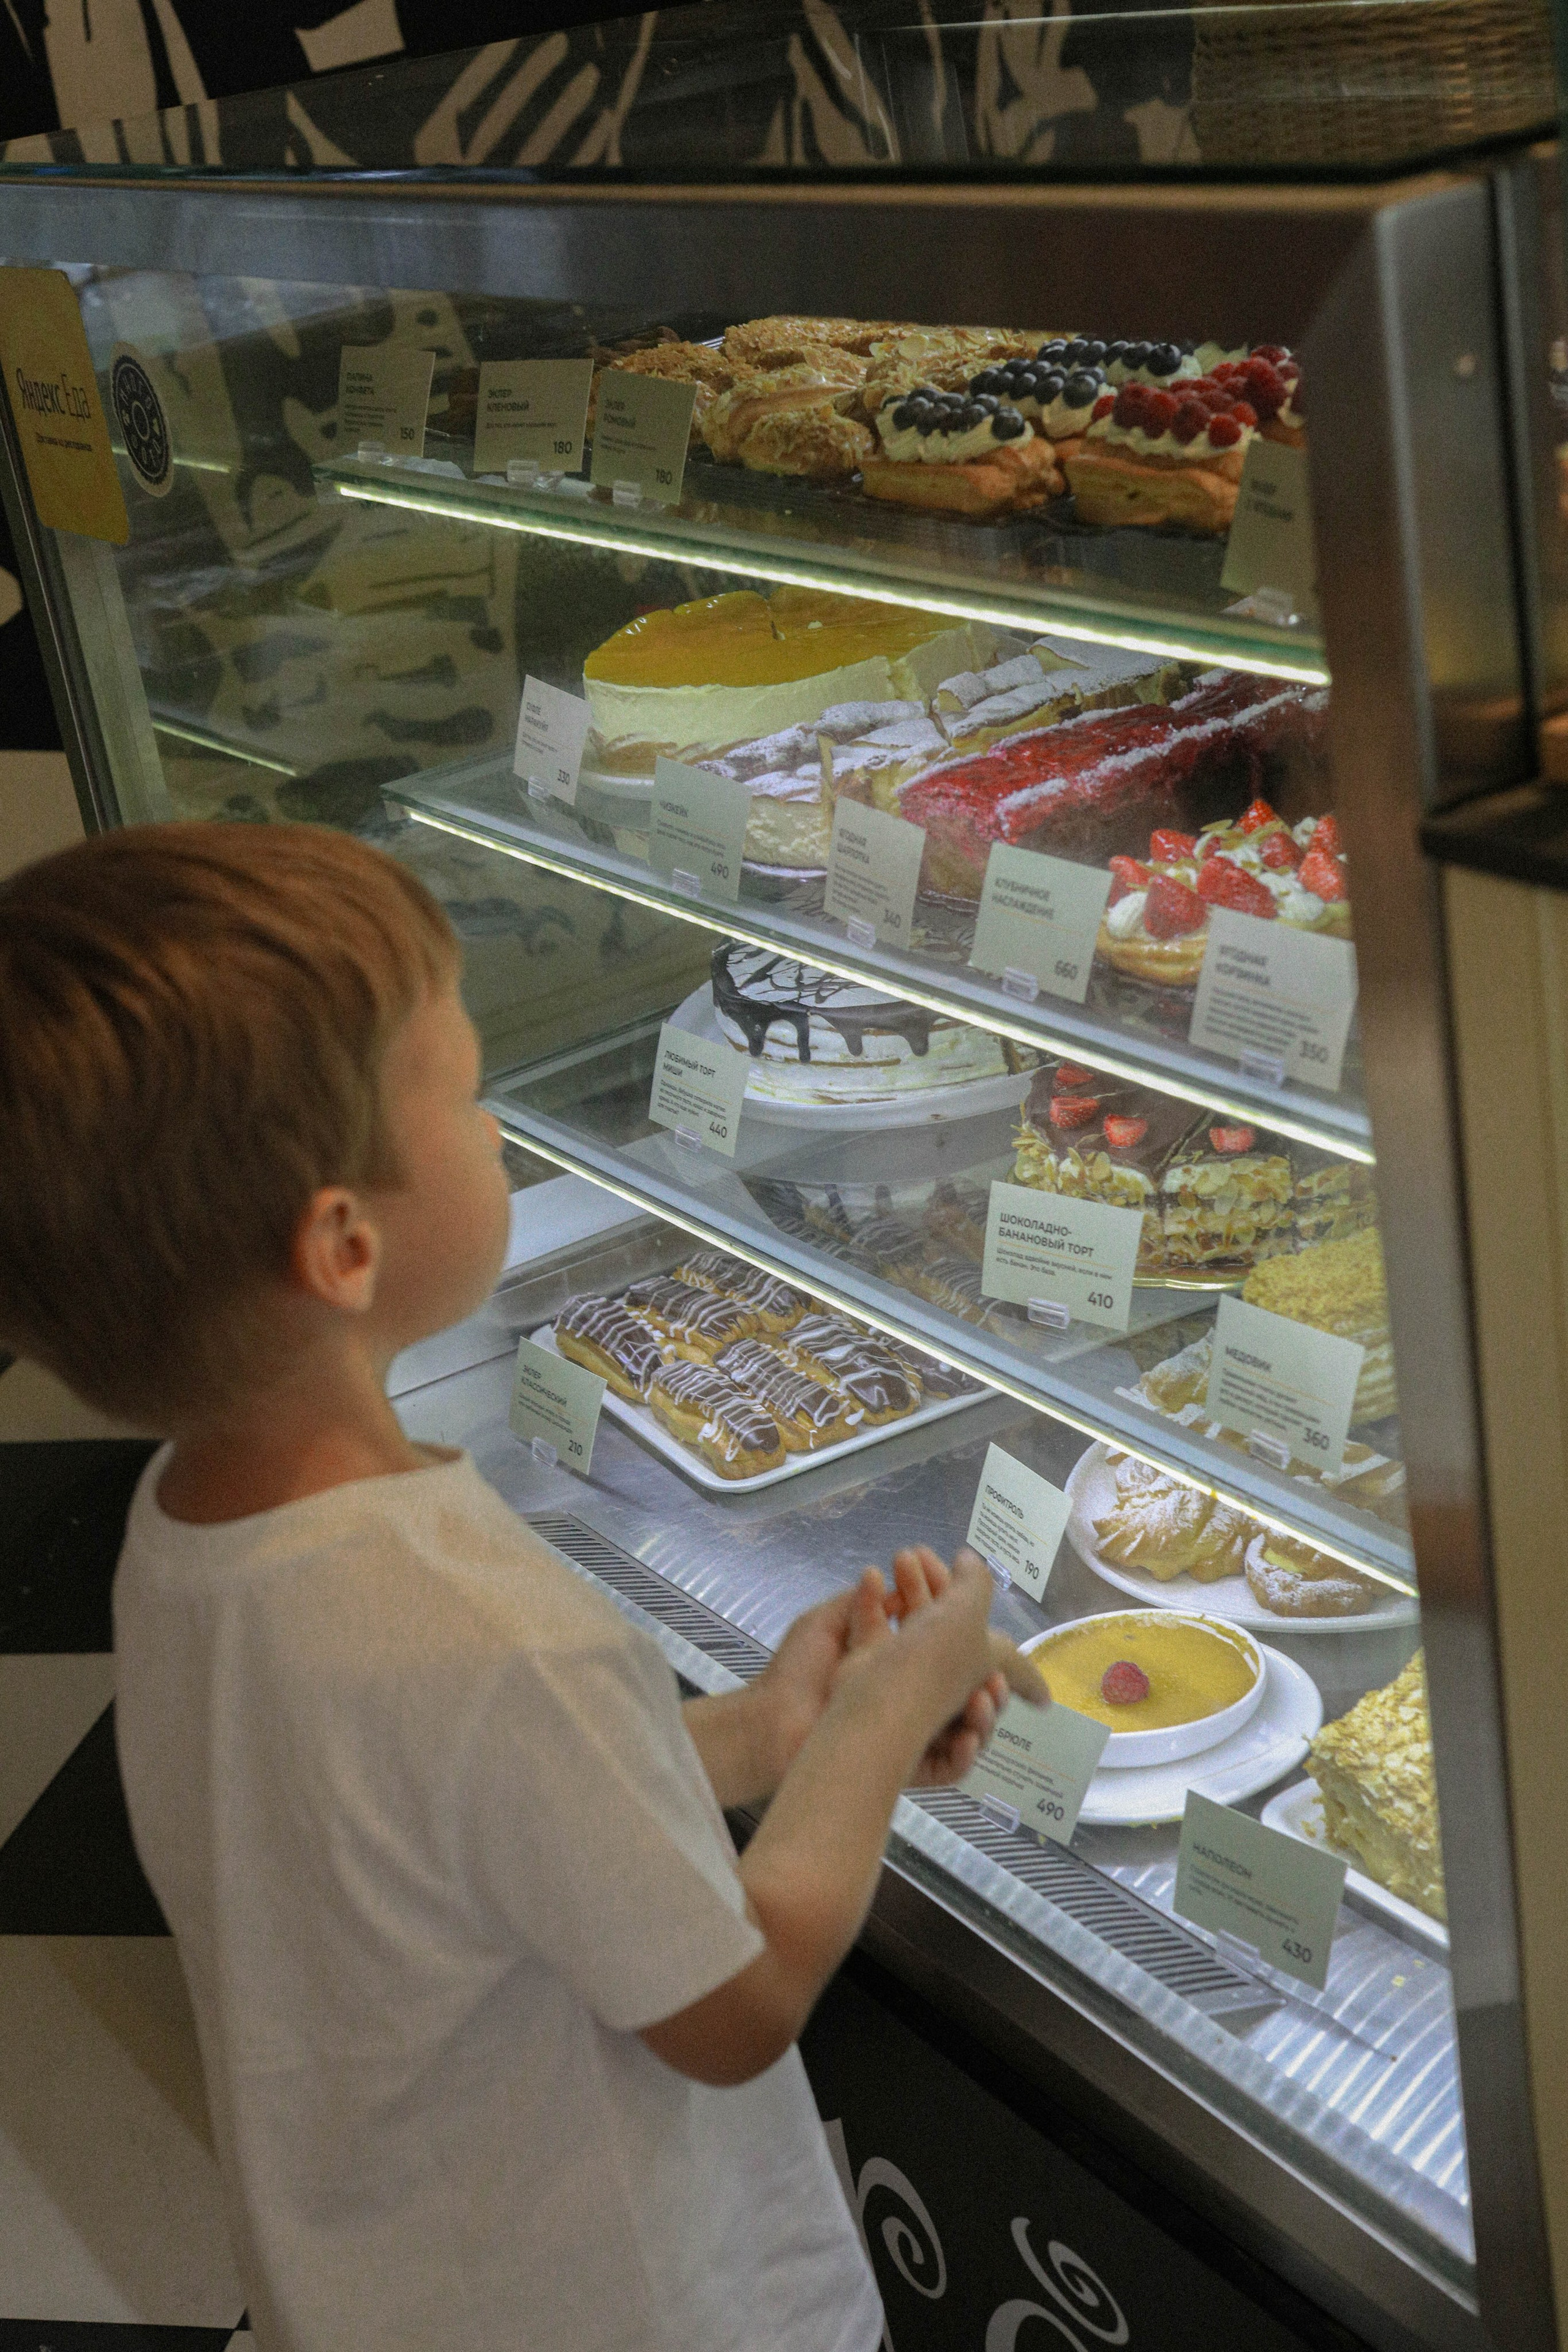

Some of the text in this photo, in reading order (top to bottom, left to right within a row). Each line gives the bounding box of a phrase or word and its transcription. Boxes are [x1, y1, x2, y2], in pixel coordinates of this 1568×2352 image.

[16, 368, 66, 417] Яндекс
[61, 373, 91, 423] Еда
[400, 427, 415, 440] 150
[553, 441, 572, 454] 180
[655, 469, 673, 485] 180
[557, 769, 570, 785] 330
[659, 799, 689, 818] ЧИЗКЕЙК
[710, 862, 729, 879] 490
[1054, 960, 1078, 980] 660
[664, 1050, 716, 1078] ЛЮБИМЫЙ ТОРТ
[709, 1121, 728, 1139] 440
[1000, 1212, 1072, 1237] ШОКОЛАДНО-
[998, 1226, 1095, 1257] БАНАНОВЫЙ ТОРТ
[1087, 1291, 1114, 1310] 410
[522, 1364, 542, 1379] ЭКЛЕР
[521, 1375, 567, 1408] КЛАССИЧЕСКИЙ
[568, 1439, 583, 1457] 210
[1302, 1427, 1330, 1450] 360
[985, 1484, 1025, 1520] ПРОФИТРОЛЬ
[1024, 1559, 1040, 1580] 190
[995, 1727, 1033, 1752] -БРЮЛЕ
[1036, 1798, 1065, 1821] 490
[1193, 1842, 1253, 1880] НАПОЛЕОН
[1281, 1938, 1312, 1963] 430
